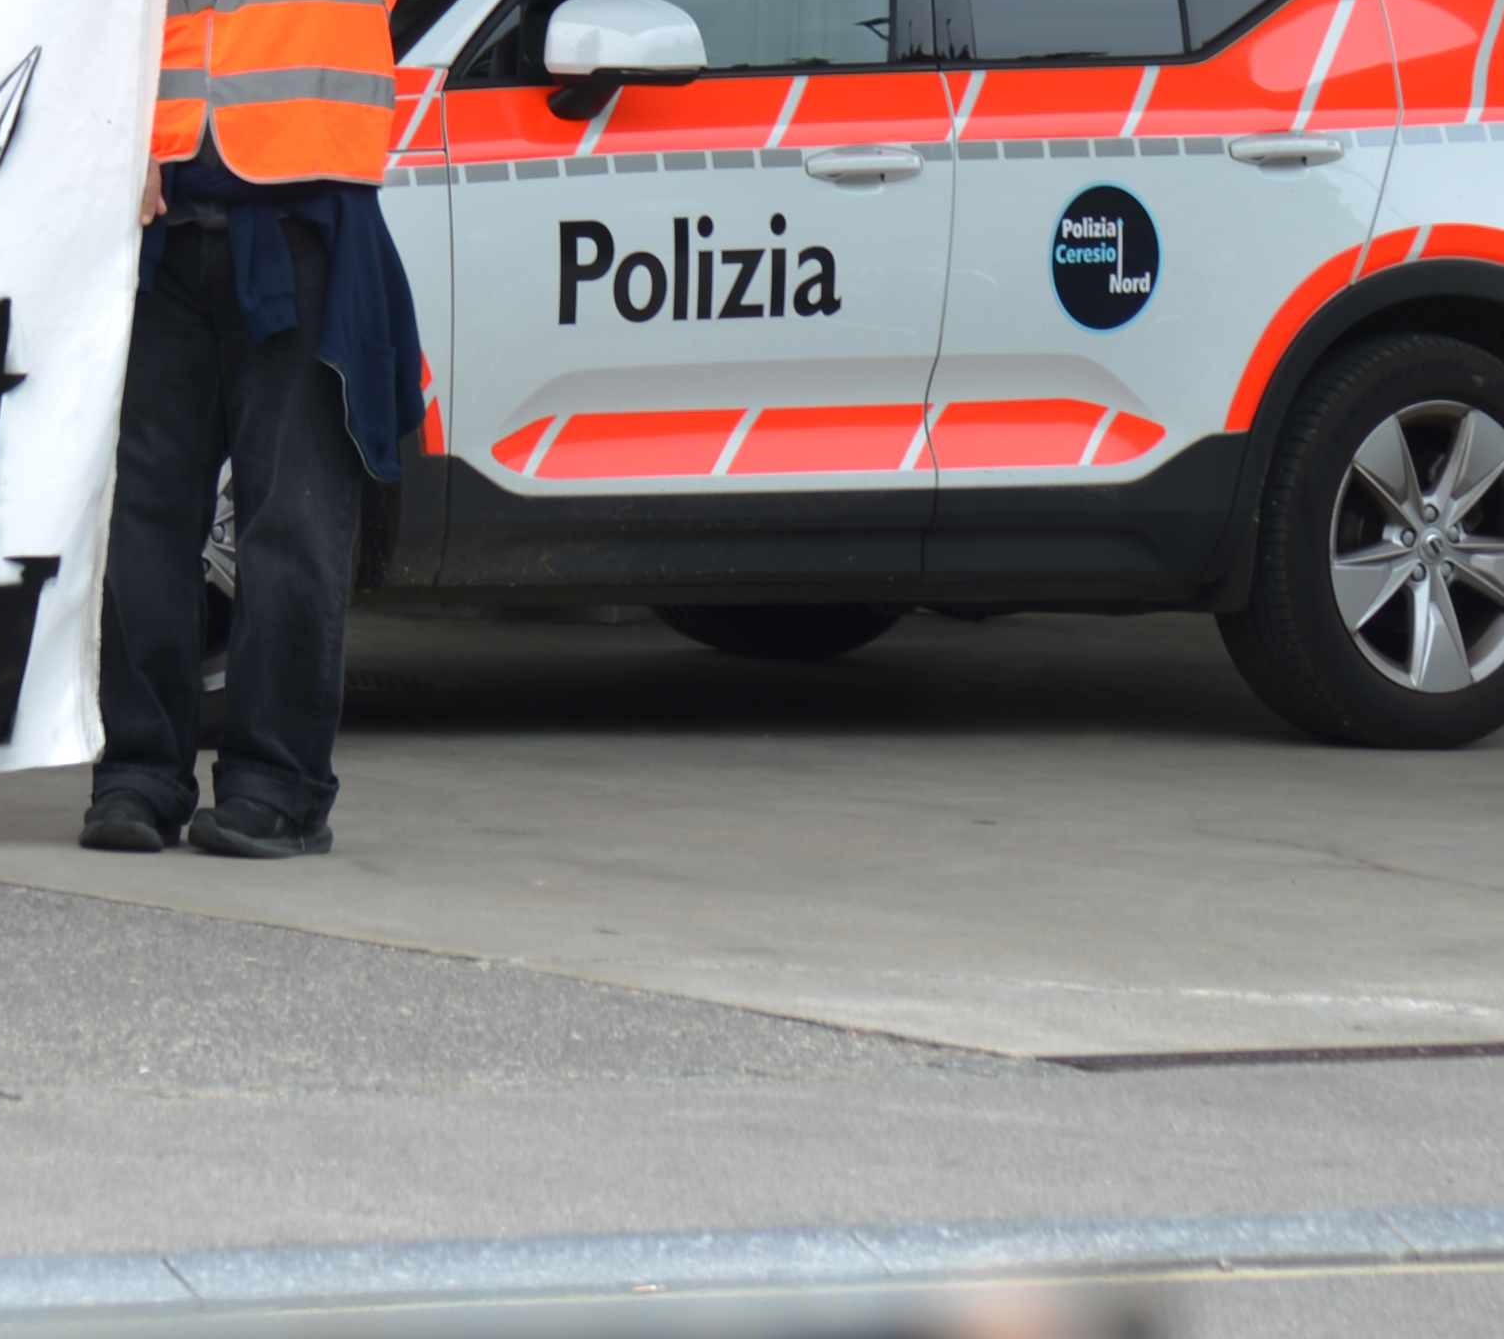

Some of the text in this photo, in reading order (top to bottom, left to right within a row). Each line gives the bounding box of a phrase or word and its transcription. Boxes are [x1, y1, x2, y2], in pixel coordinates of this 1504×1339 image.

[1061, 215, 1117, 240] Polizia
[1055, 241, 1117, 265] Ceresio
[558, 212, 842, 327] Polizia
[1108, 270, 1152, 294] Nord
